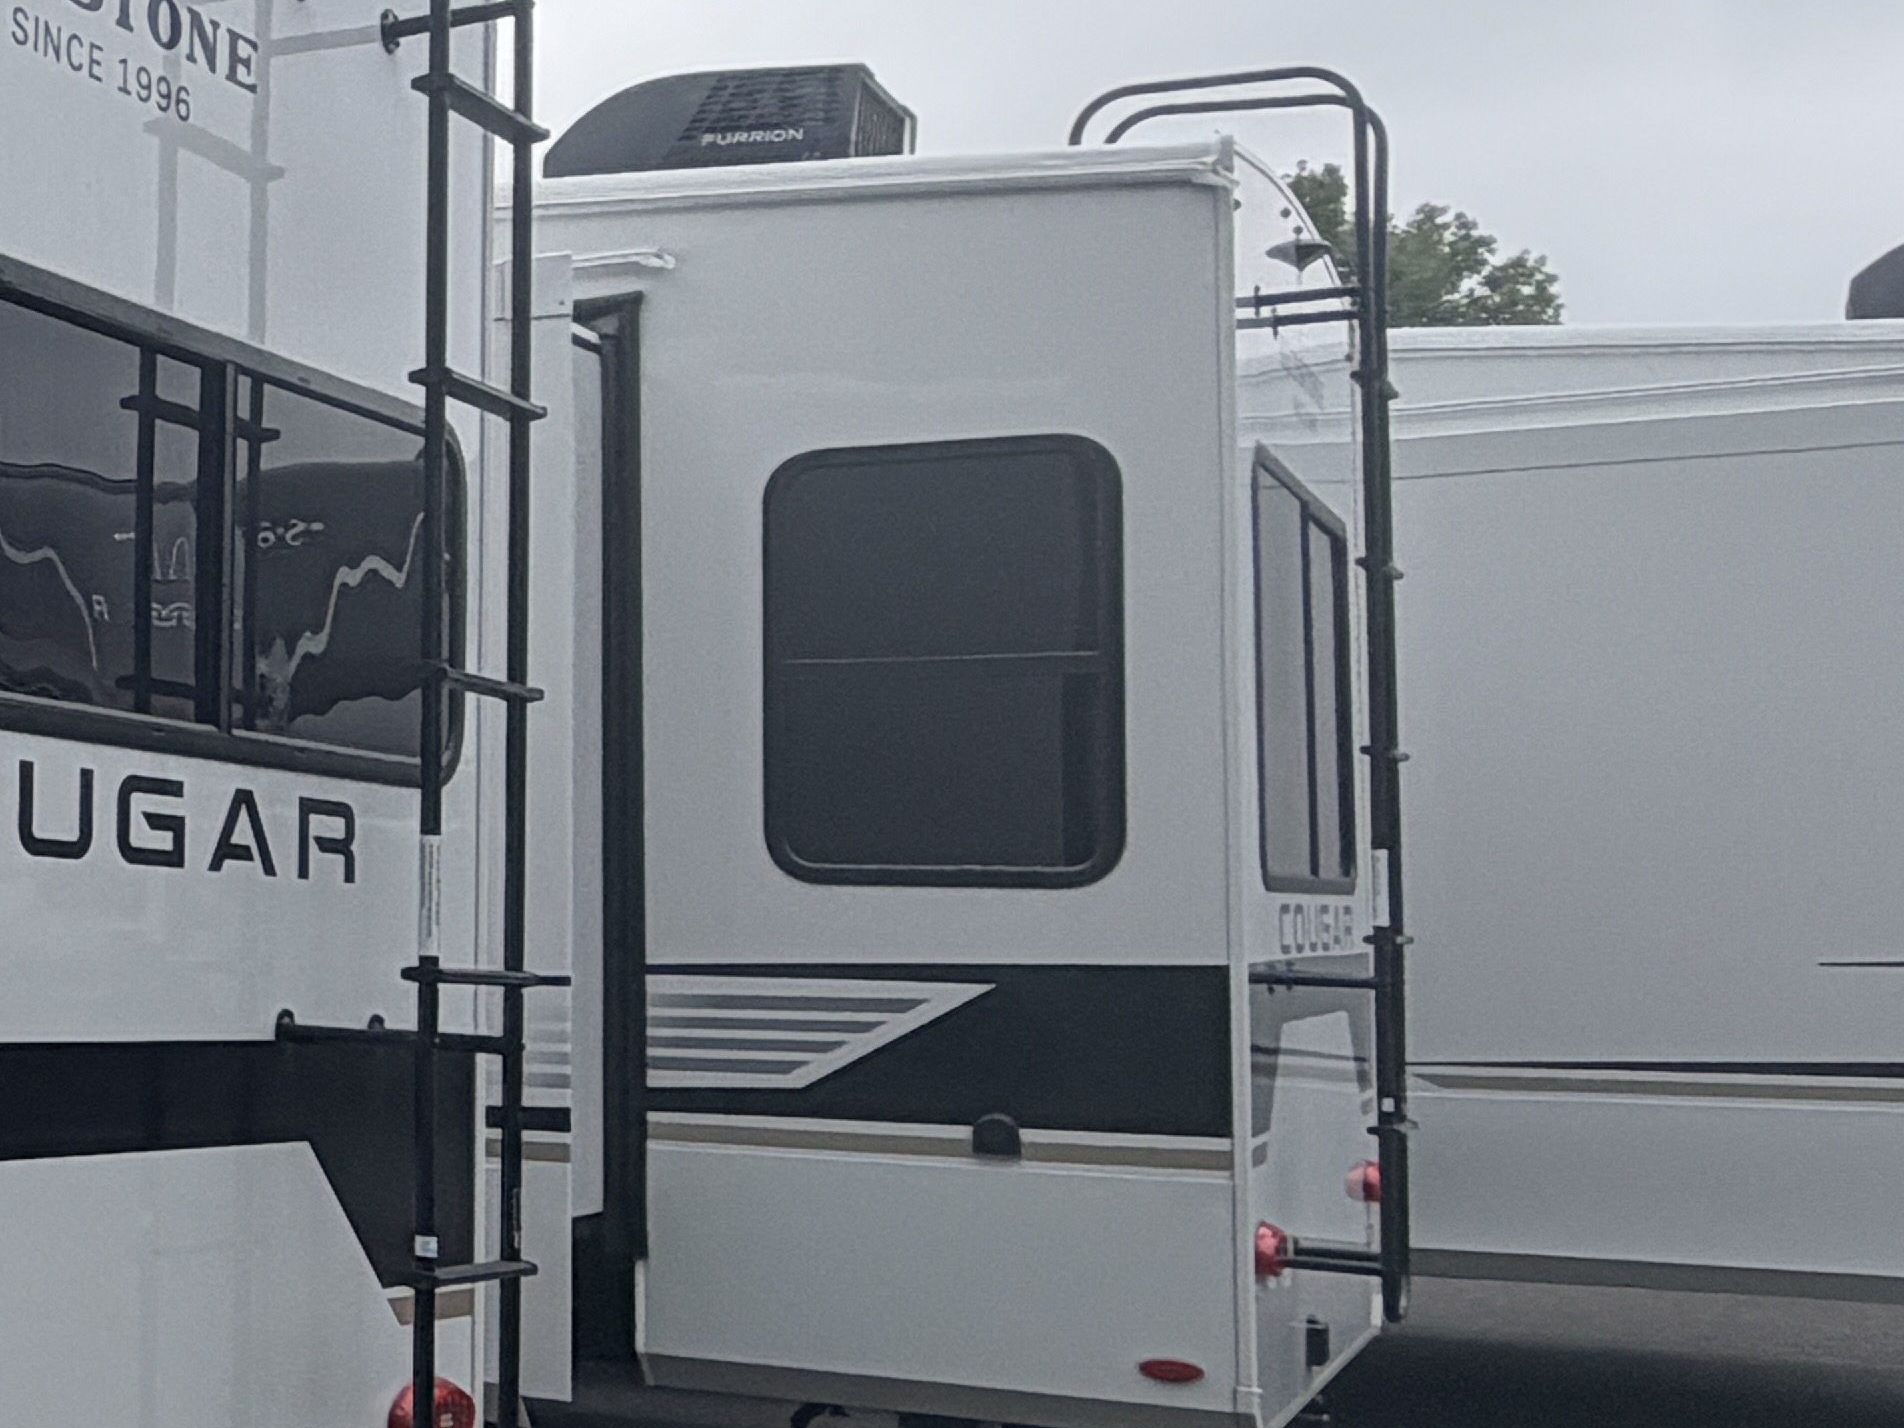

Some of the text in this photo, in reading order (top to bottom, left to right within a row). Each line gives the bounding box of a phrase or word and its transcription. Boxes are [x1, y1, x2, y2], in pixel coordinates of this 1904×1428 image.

[11, 6, 191, 122] SINCE 1996
[700, 128, 804, 147] FURRION
